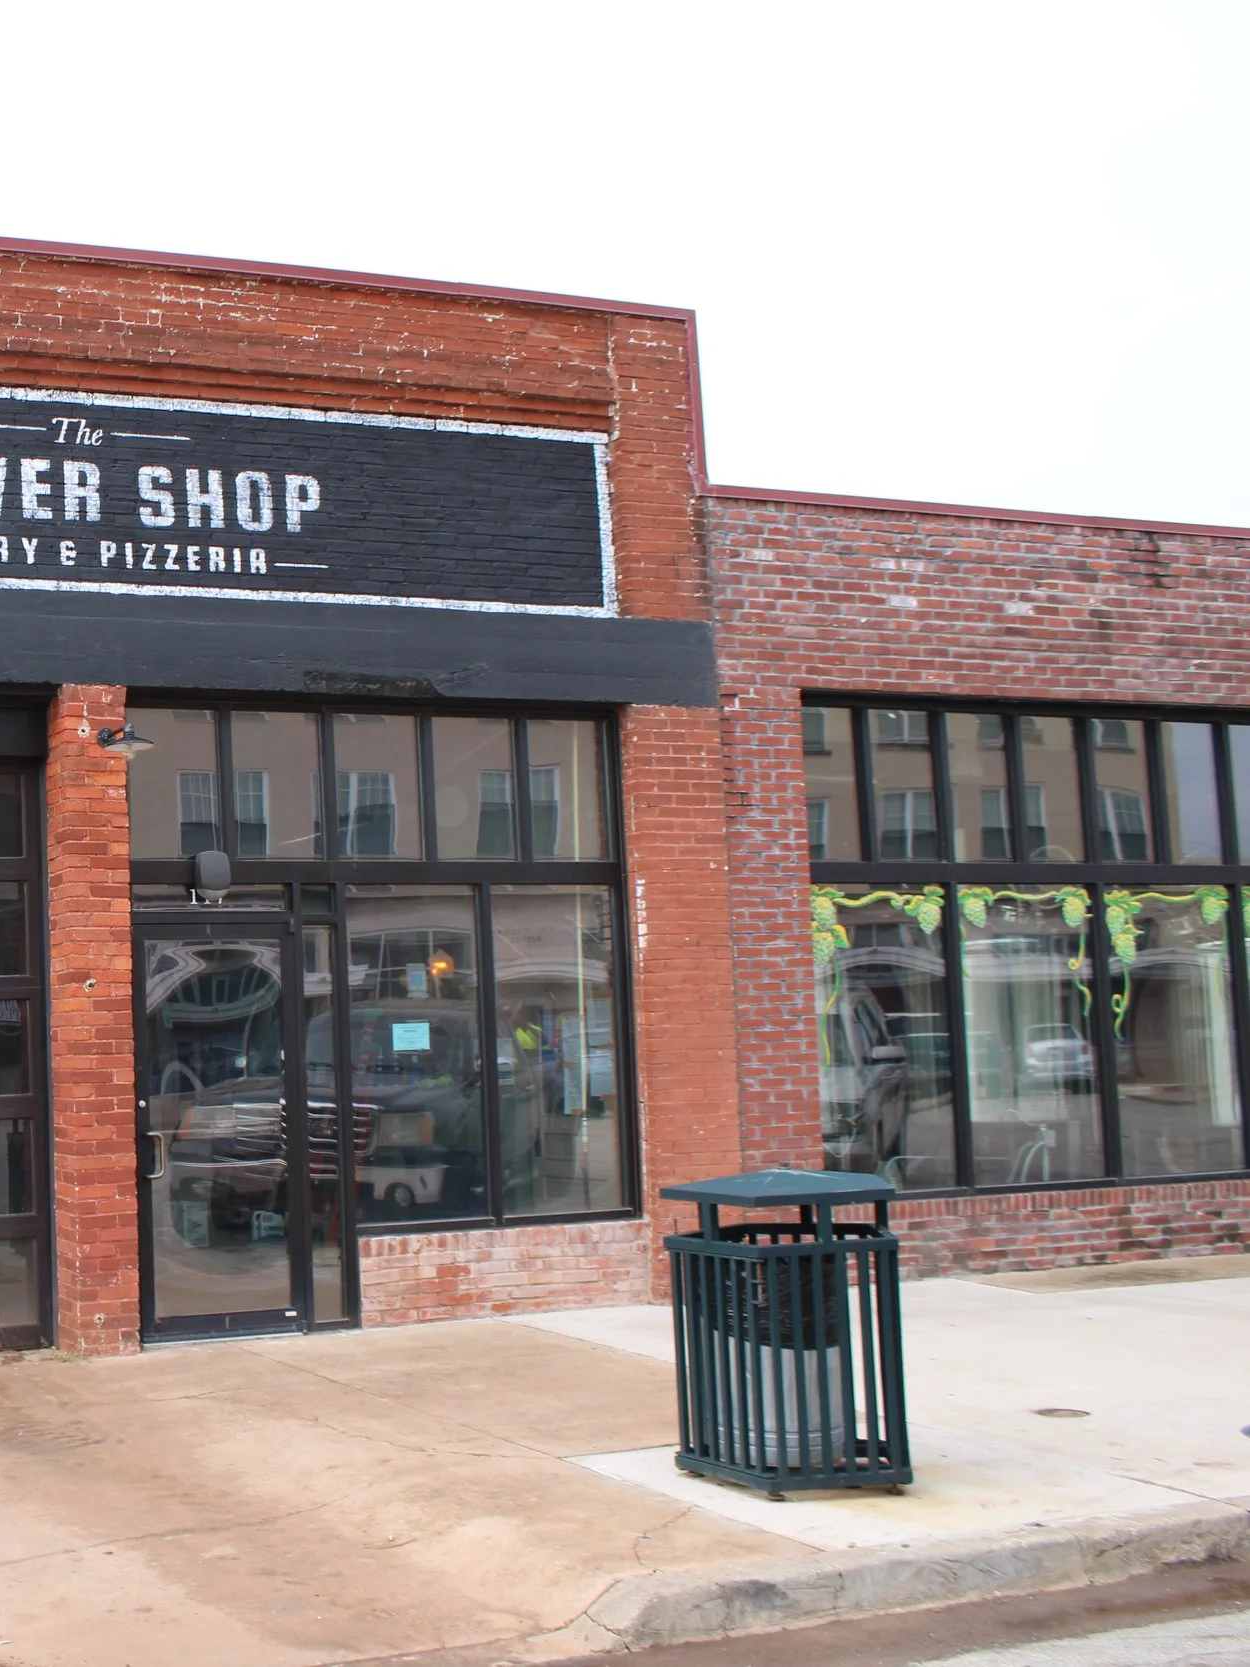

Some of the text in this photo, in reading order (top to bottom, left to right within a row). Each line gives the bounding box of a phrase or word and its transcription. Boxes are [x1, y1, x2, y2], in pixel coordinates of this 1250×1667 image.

[52, 417, 104, 447] The
[138, 465, 321, 533] SHOP
[100, 540, 268, 575] PIZZERIA
